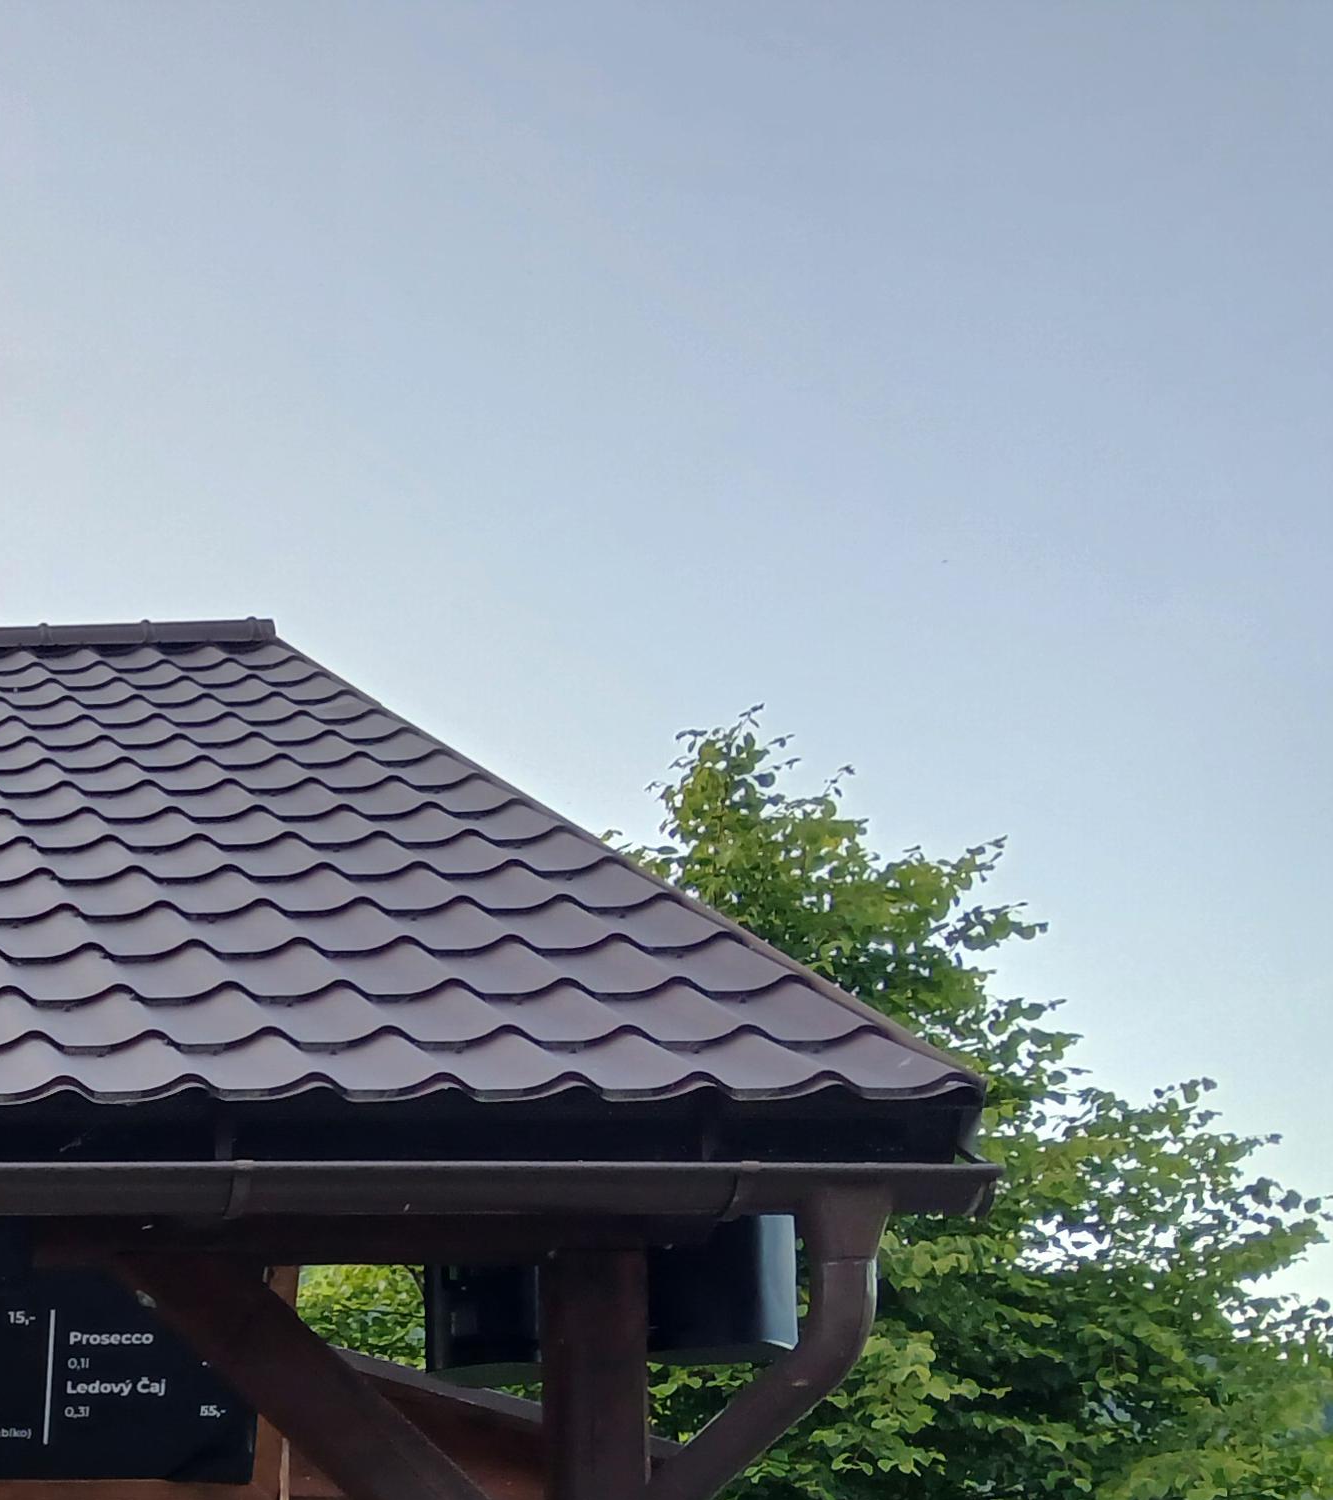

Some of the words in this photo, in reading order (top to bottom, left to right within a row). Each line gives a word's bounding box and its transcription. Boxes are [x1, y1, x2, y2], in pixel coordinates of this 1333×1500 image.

[7, 1310, 36, 1326] 15,-
[69, 1331, 154, 1345] Prosecco
[66, 1379, 133, 1397] Ledový
[136, 1376, 166, 1397] Čaj
